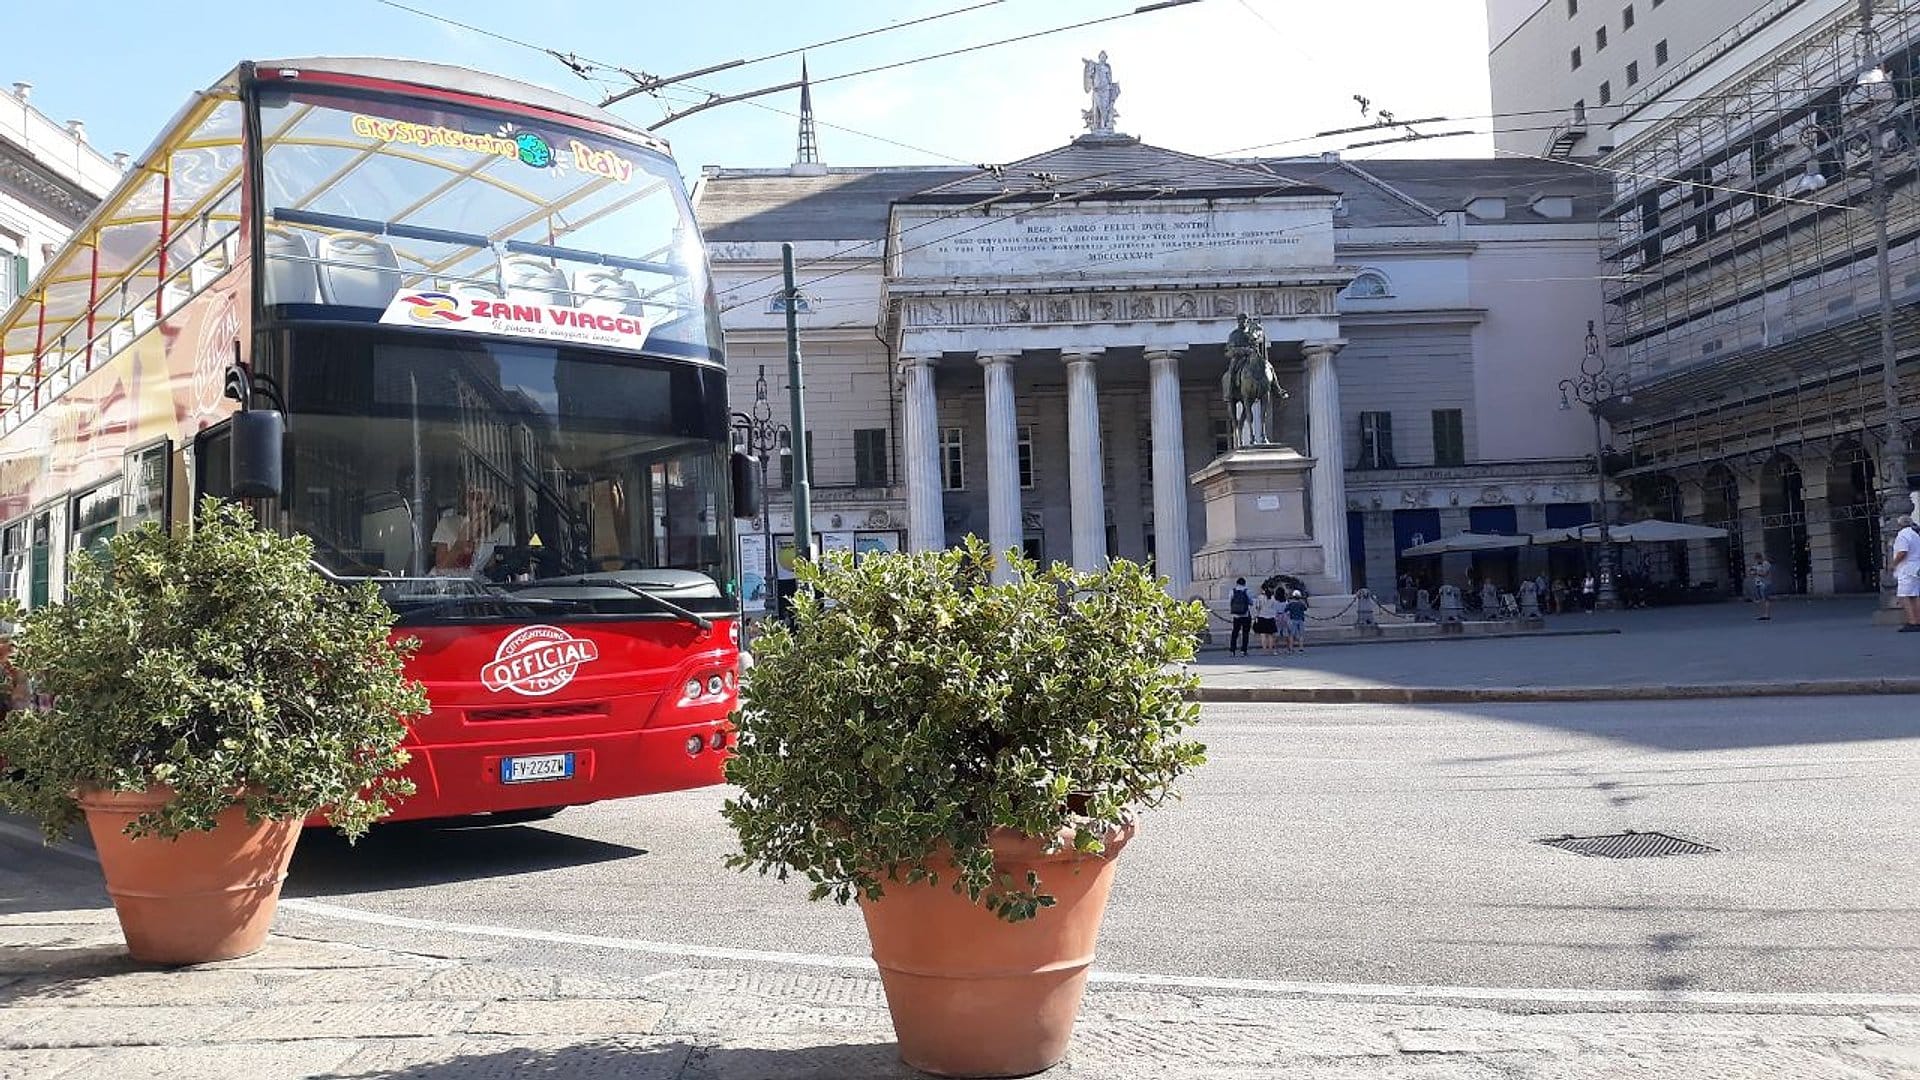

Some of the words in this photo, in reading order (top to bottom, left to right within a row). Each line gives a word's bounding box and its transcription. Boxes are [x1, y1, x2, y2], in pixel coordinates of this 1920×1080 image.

[353, 115, 518, 159] CitySightseeing
[570, 140, 632, 183] Italy
[471, 300, 542, 323] ZANI
[549, 309, 642, 335] VIAGGI
[494, 642, 592, 683] OFFICIAL
[528, 669, 571, 689] TOUR
